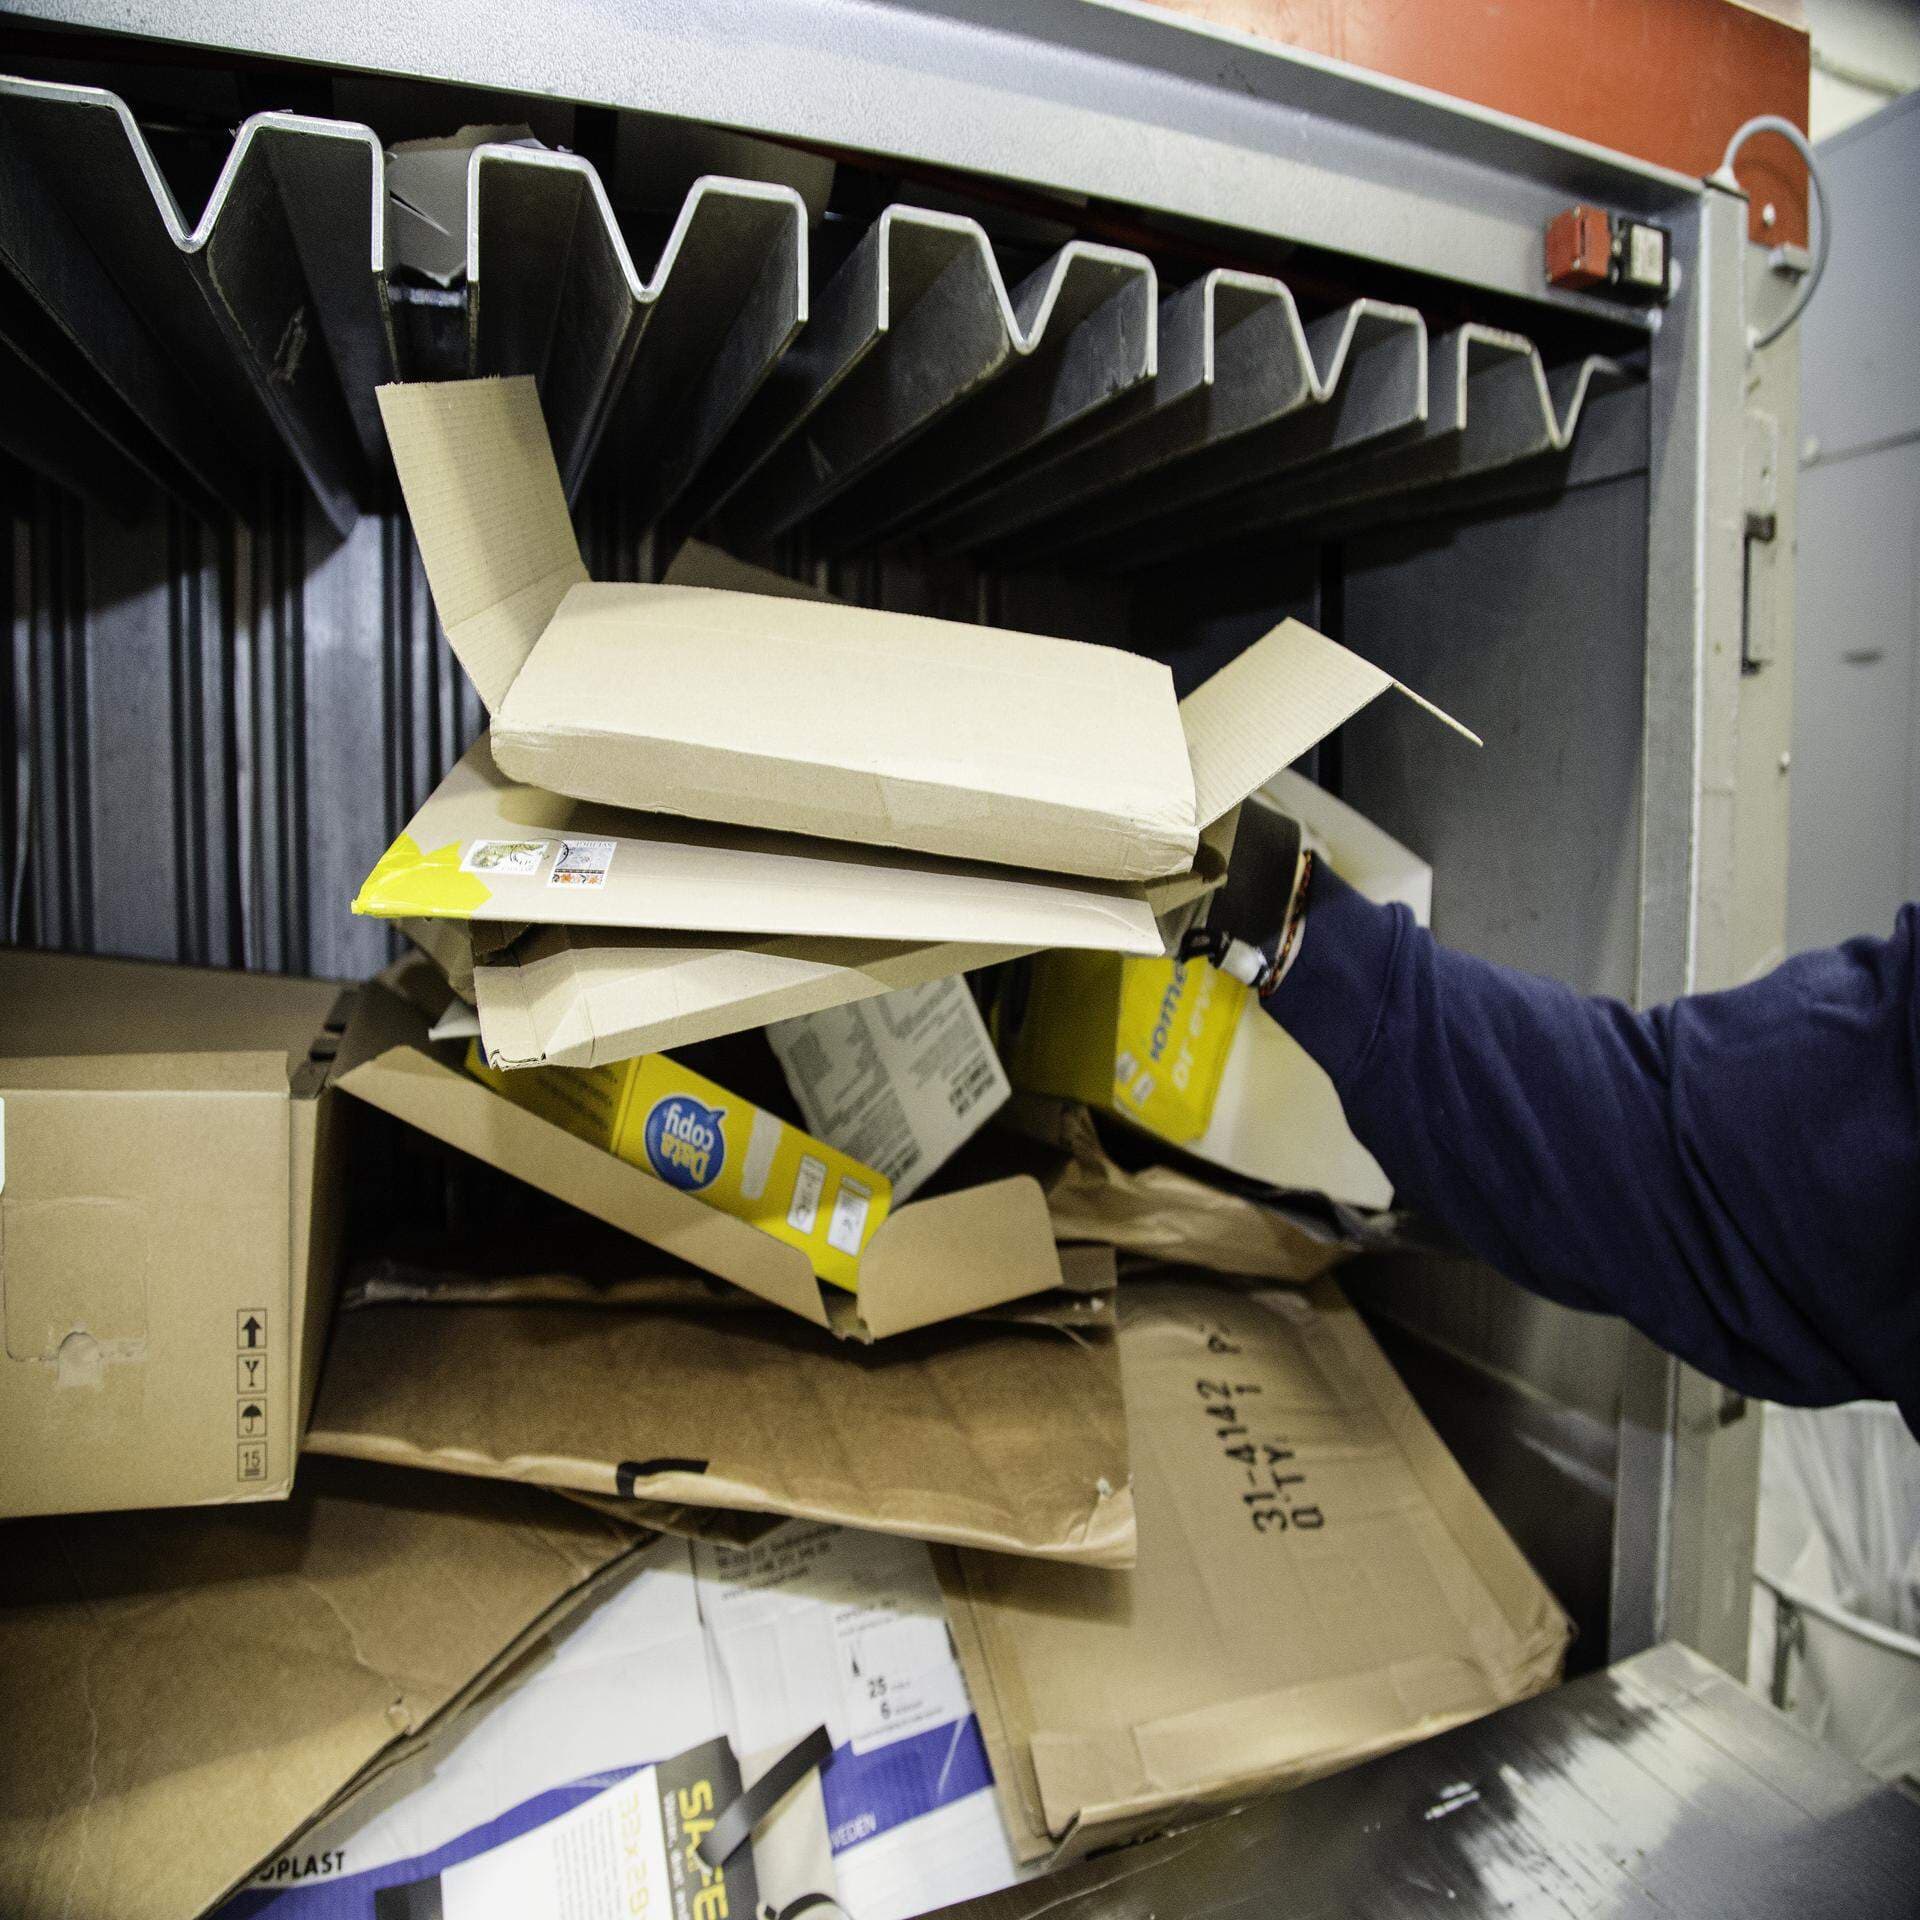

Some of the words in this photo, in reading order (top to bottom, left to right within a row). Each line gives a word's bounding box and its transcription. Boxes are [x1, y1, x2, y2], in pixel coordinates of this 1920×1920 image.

[664, 1102, 715, 1151] copy
[661, 1133, 710, 1184] Data
[242, 1451, 262, 1468] 15
[1195, 1379, 1288, 1534] 31-4142
